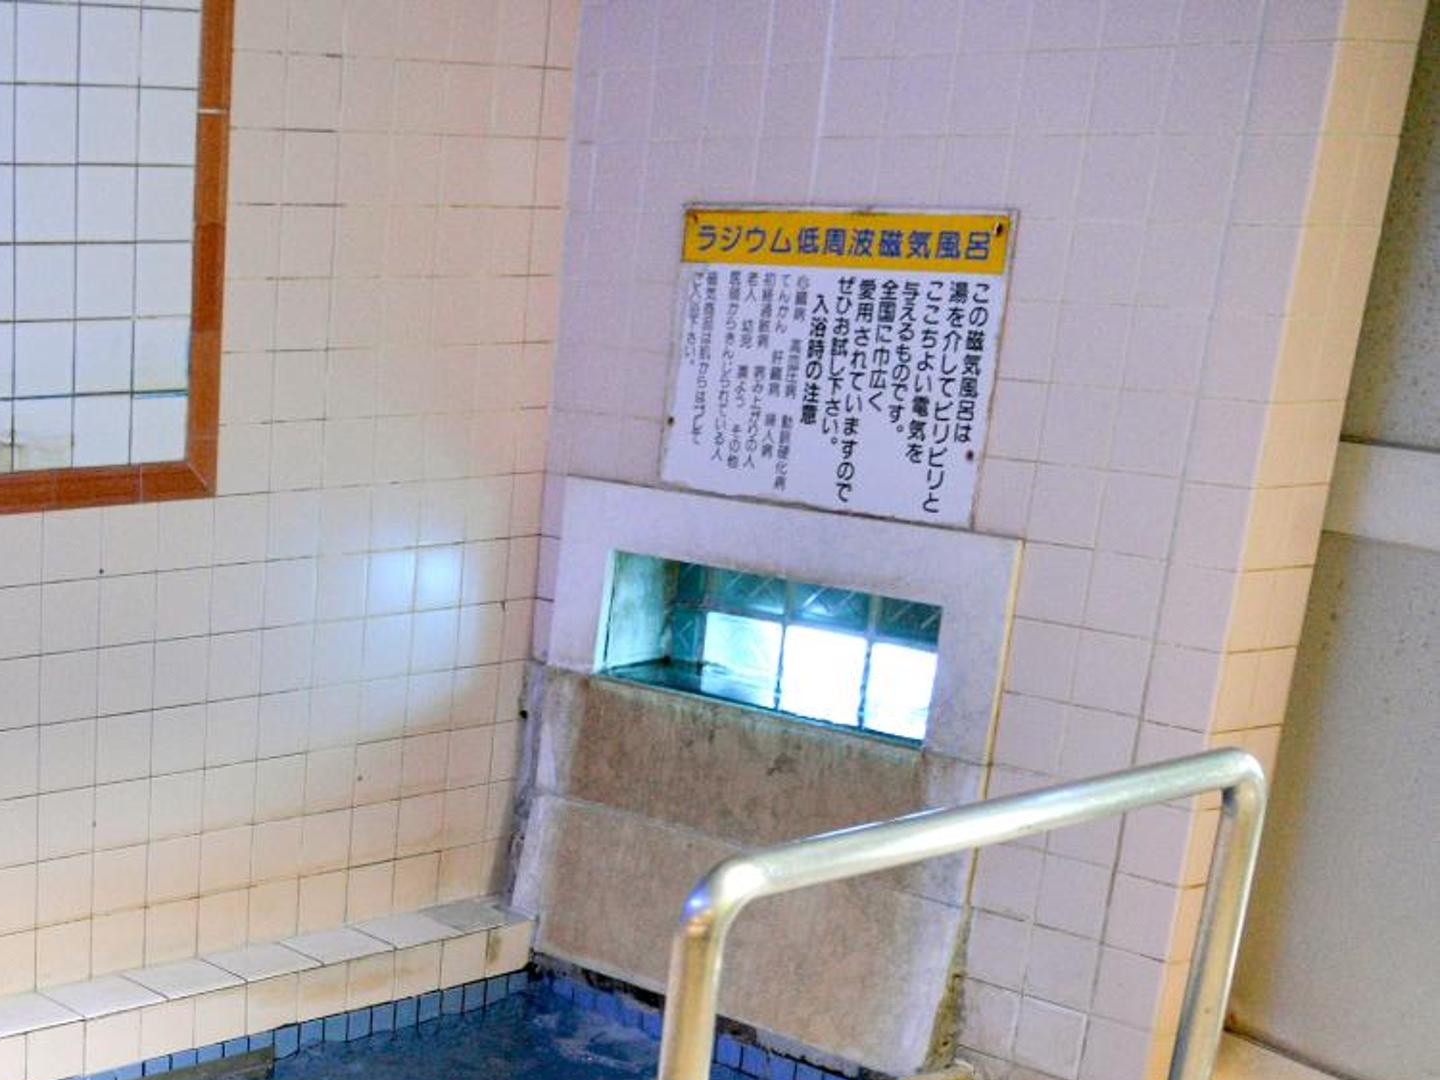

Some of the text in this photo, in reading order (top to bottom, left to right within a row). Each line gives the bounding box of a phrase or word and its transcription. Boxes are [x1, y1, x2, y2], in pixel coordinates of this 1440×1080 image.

[697, 225, 991, 259] ラジウム低周波磁気風呂
[801, 294, 829, 425] 入浴時の注意
[822, 277, 856, 445] ぜひお試し下さい。
[836, 279, 877, 501] 愛用されていますので
[869, 280, 898, 412] 全国に巾広く
[889, 282, 920, 433] 与えるものです。
[908, 282, 943, 464] ここちよい電気を
[953, 283, 990, 442] この磁気風呂は
